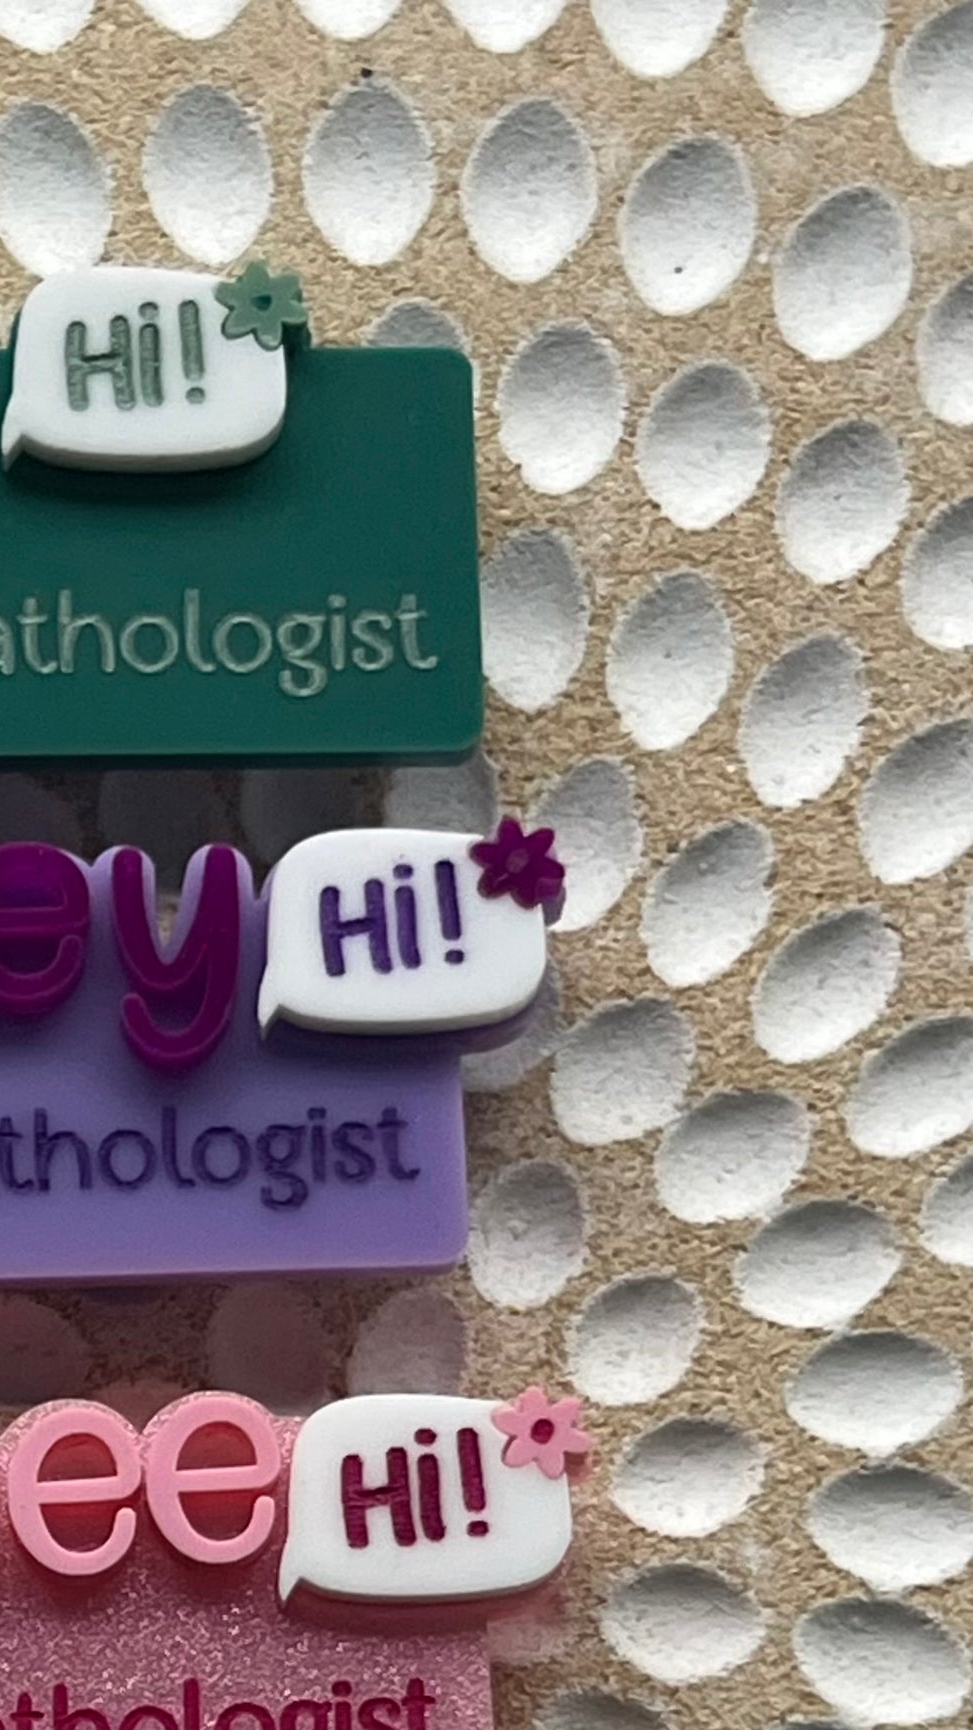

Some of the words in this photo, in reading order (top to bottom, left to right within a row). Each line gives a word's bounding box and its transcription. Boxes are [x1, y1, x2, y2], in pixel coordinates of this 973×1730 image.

[64, 299, 206, 410] Hi!
[319, 859, 467, 977] Hi!
[342, 1427, 491, 1548] Hi!
